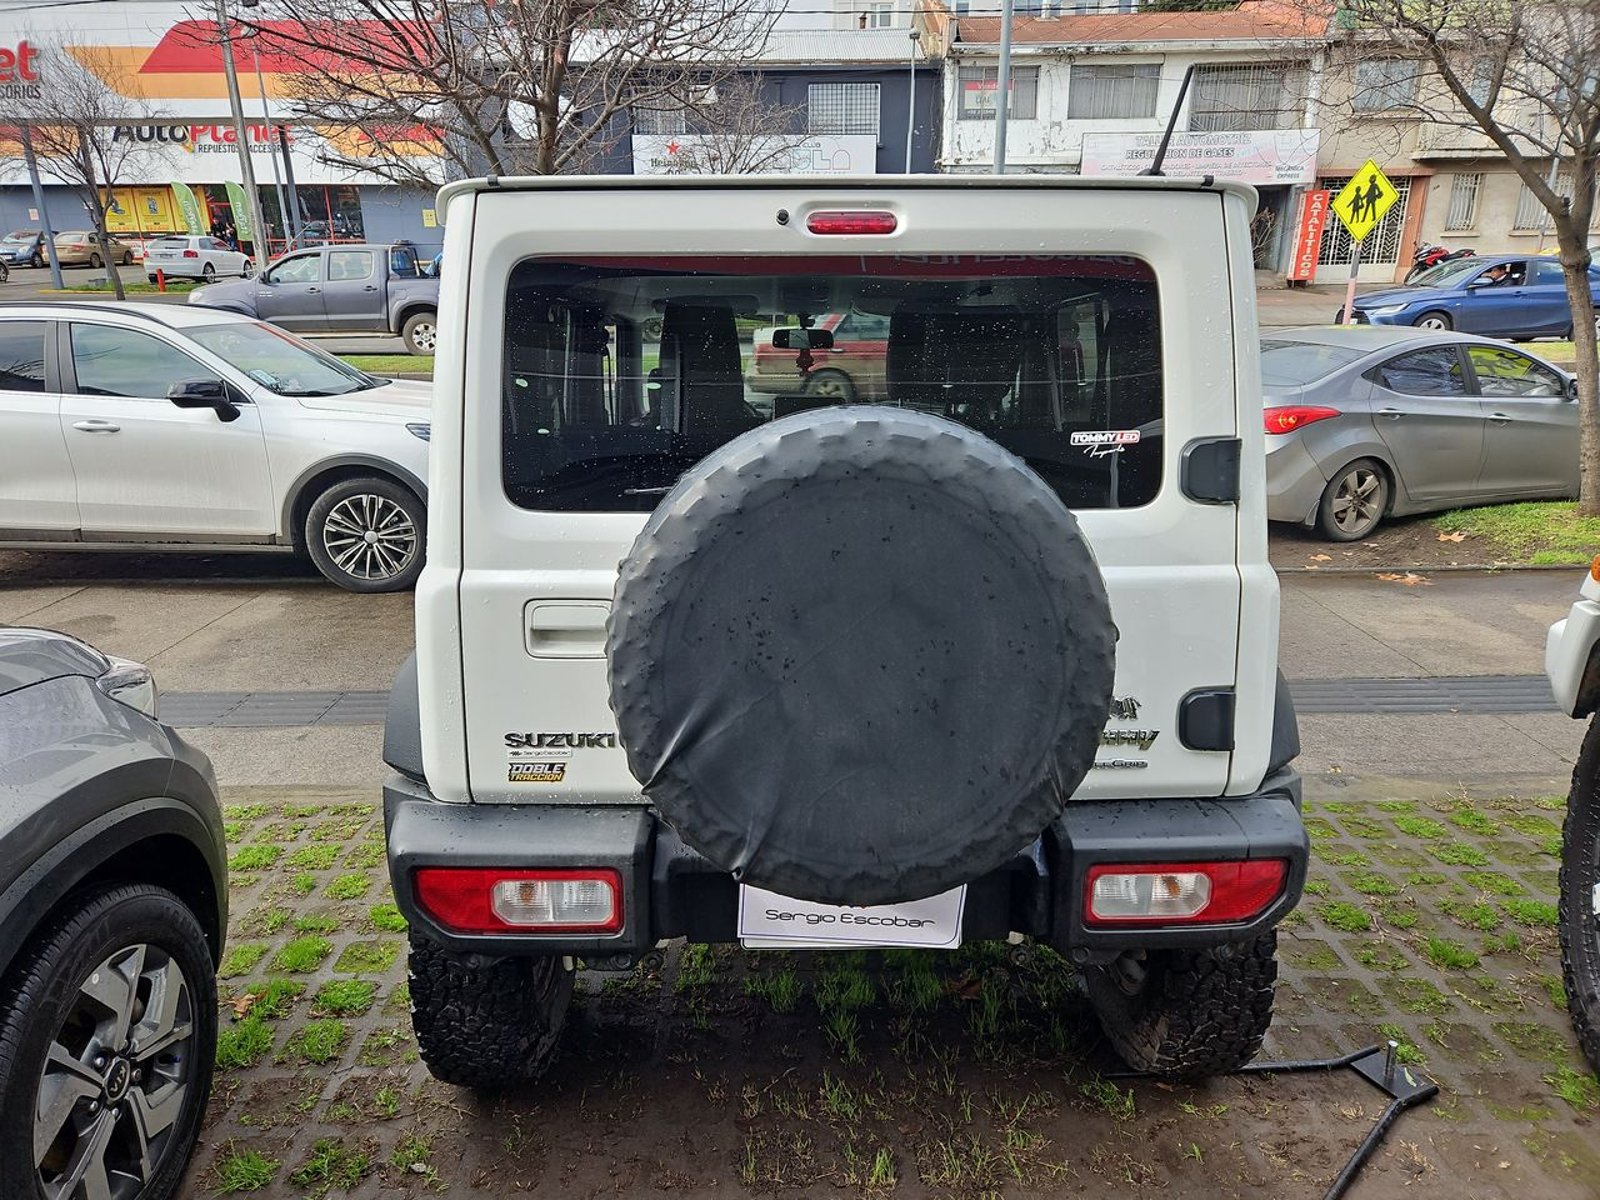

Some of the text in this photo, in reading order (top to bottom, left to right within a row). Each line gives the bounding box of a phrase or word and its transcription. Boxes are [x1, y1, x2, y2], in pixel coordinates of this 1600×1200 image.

[1136, 133, 1252, 146] TALLR AUTOMOTRIZ
[248, 143, 295, 153] ACCESORS
[1126, 147, 1235, 160] REGULION DE GASES
[1300, 193, 1324, 277] CATALITICOS
[1073, 432, 1138, 443] TOMMY LED
[504, 732, 616, 749] SUZUKI
[511, 764, 564, 773] DOBLE
[765, 909, 936, 928] Sergio Escobar
